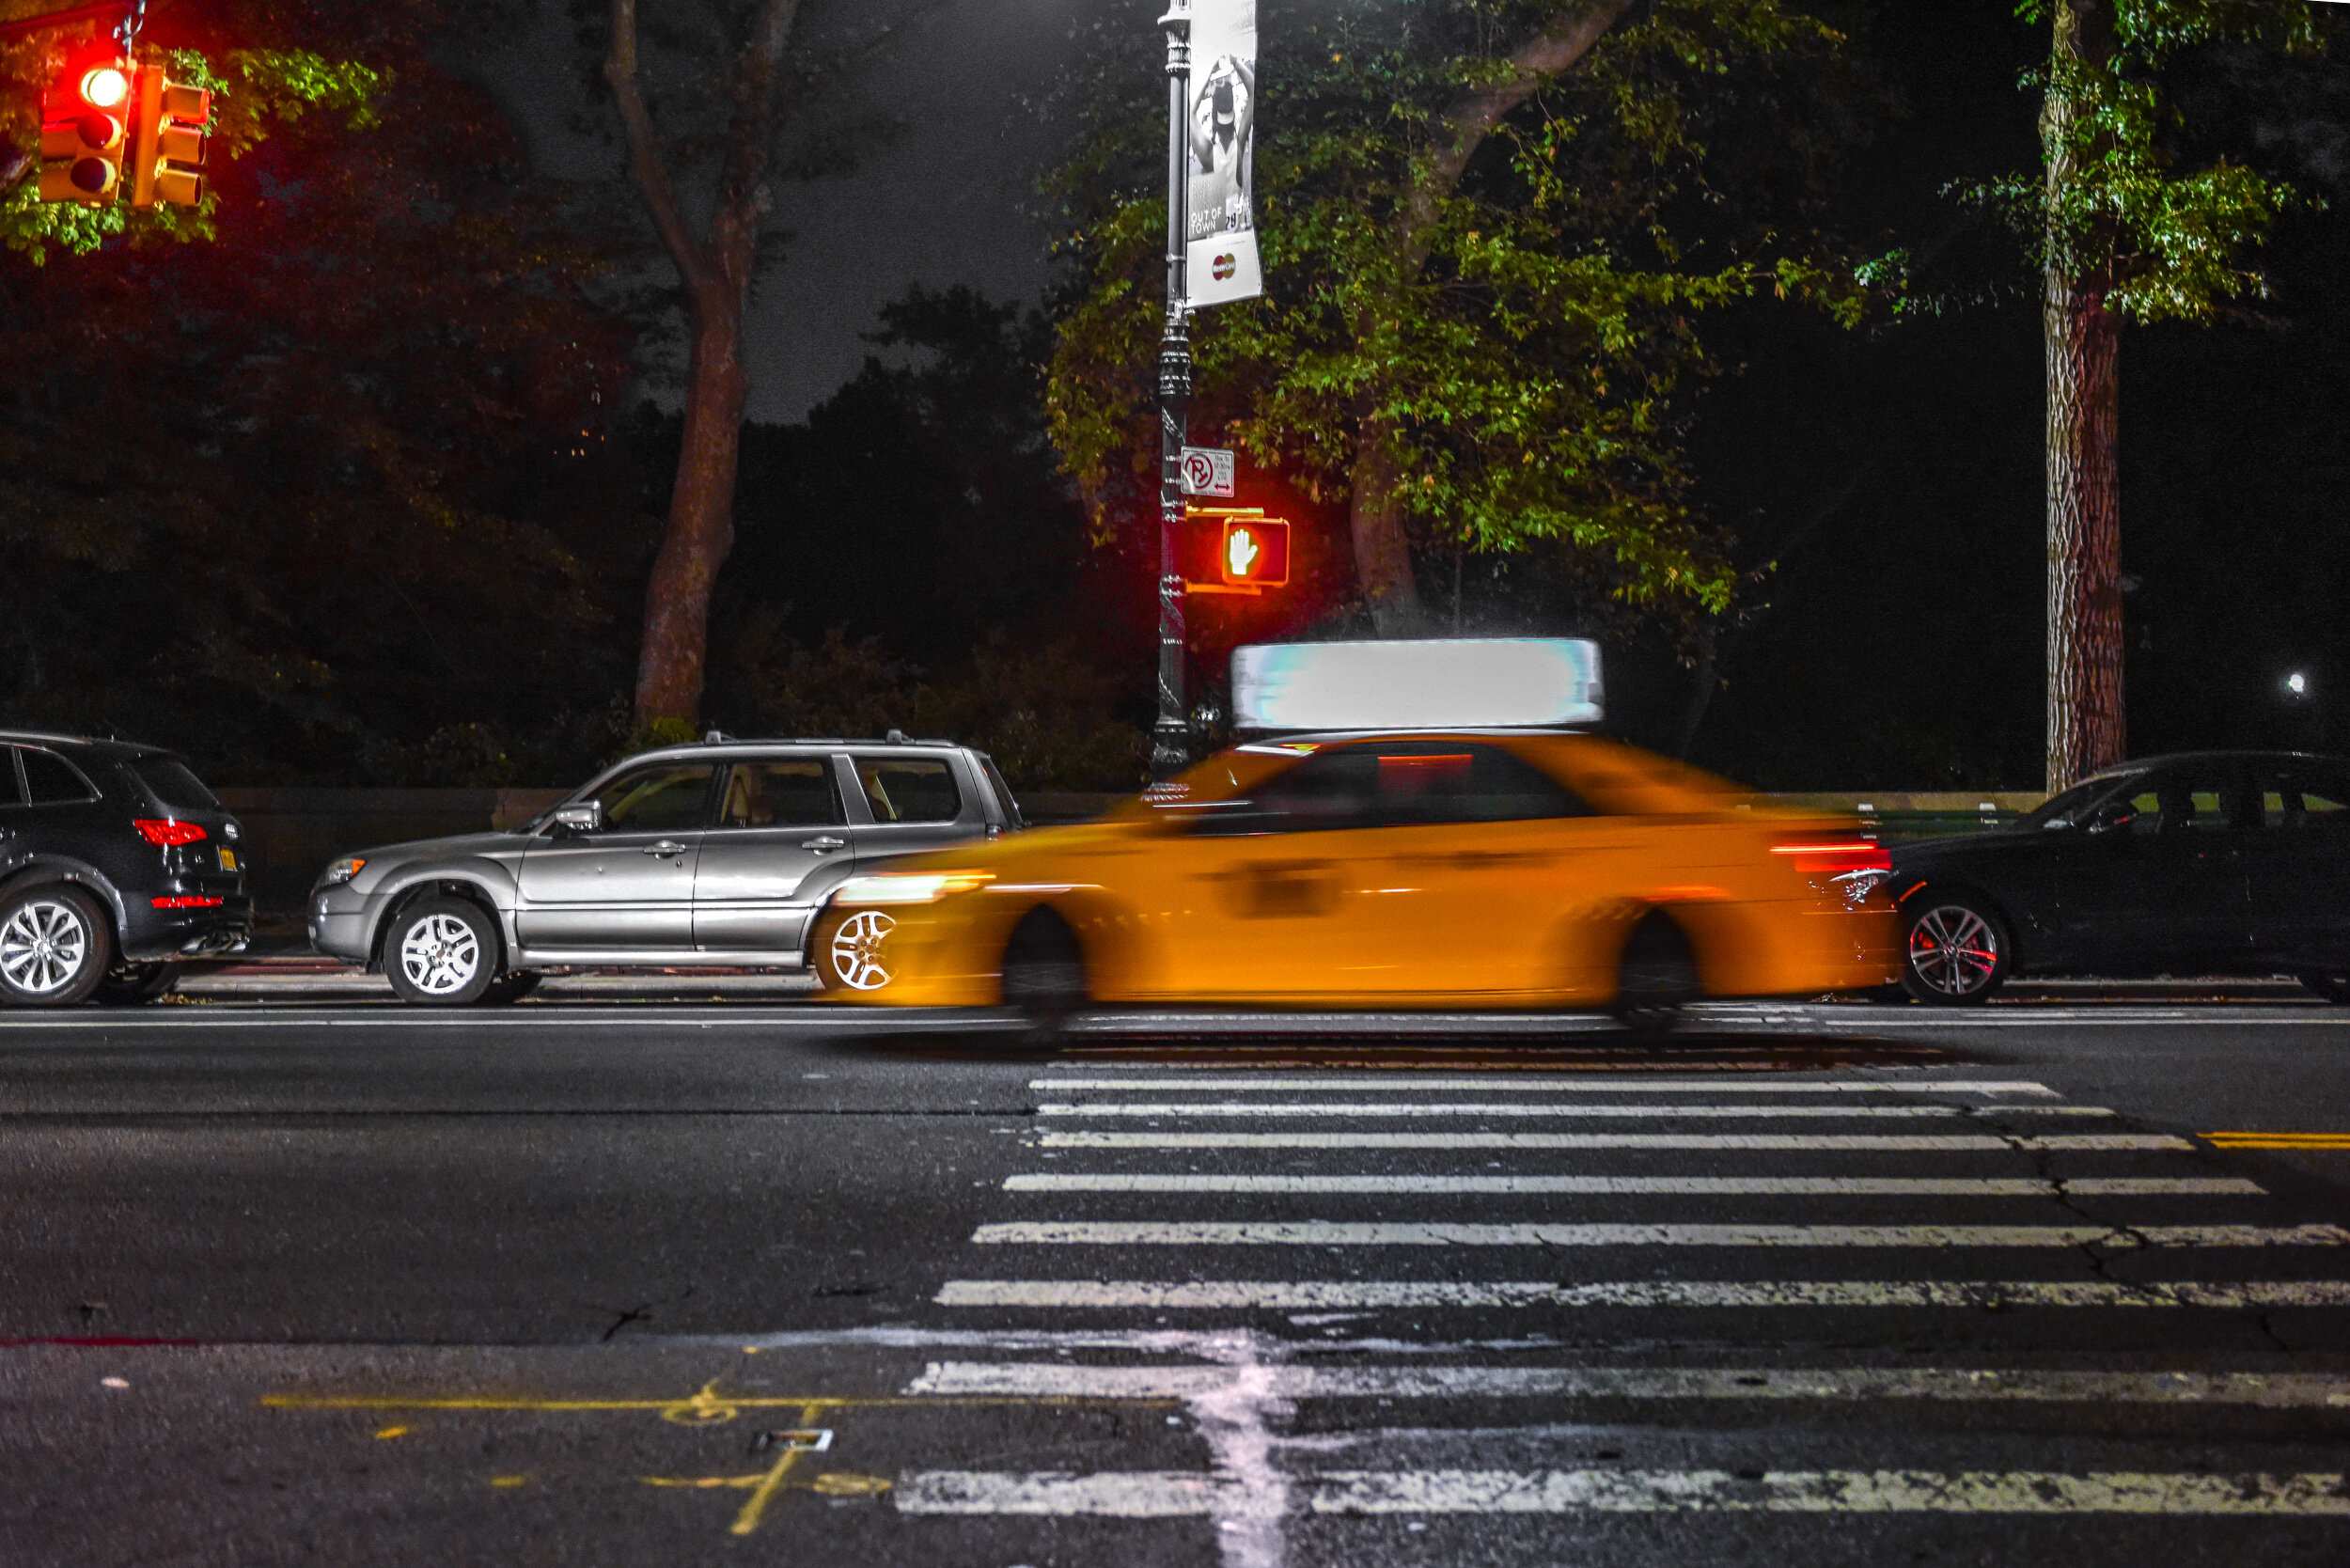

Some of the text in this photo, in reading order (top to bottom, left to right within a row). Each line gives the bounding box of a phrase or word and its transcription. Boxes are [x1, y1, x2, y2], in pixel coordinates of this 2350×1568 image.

[1191, 206, 1222, 224] OUT OF
[1191, 220, 1216, 235] TOWN
